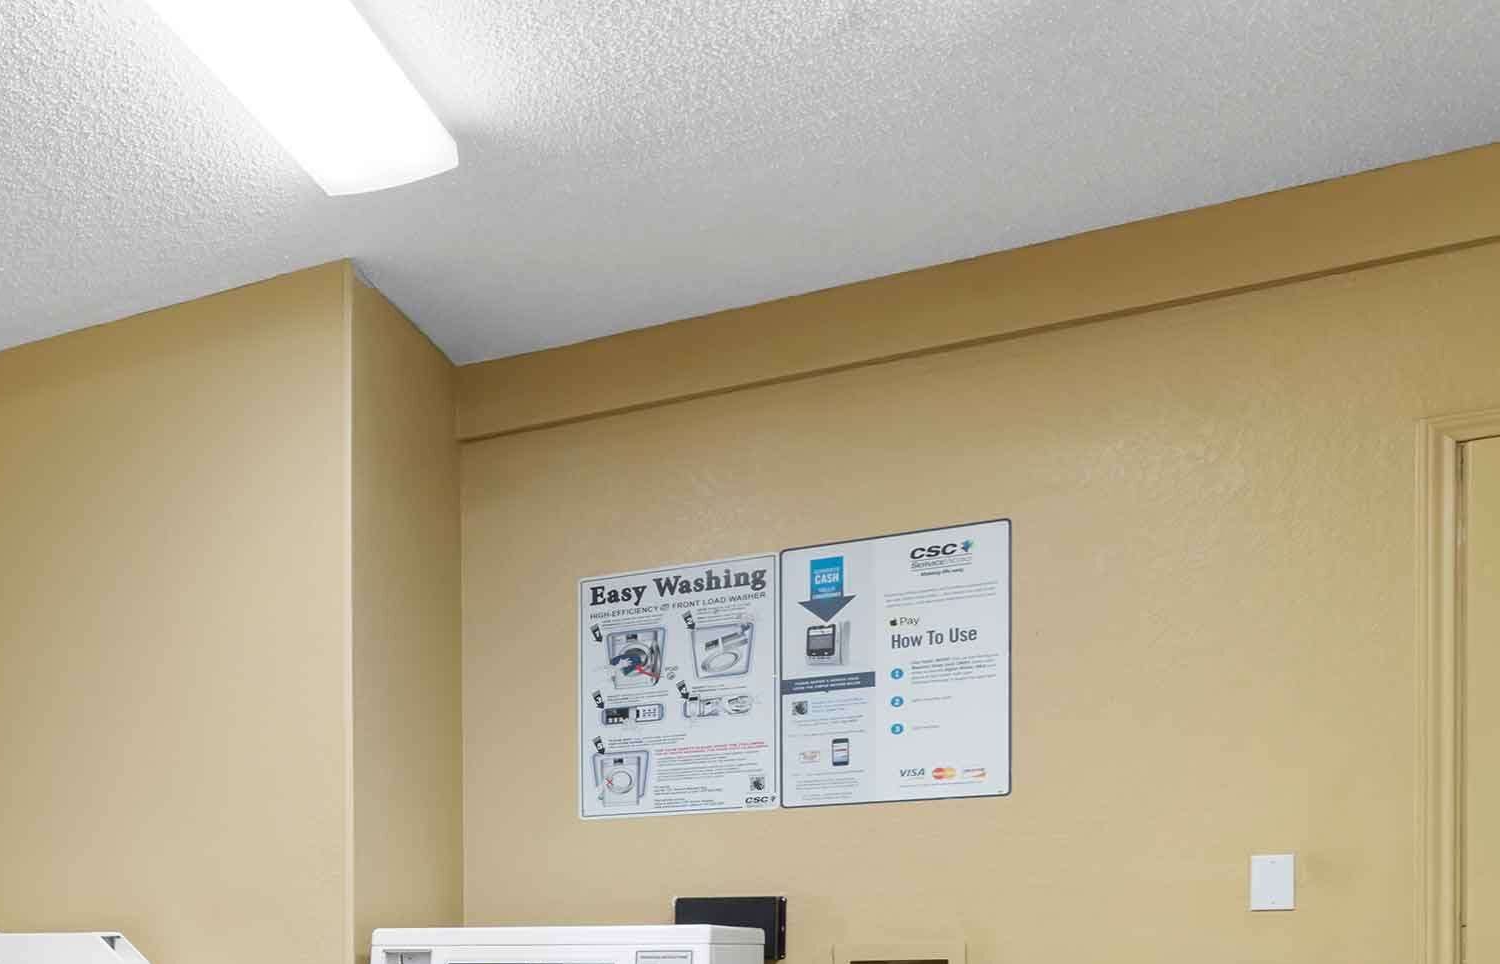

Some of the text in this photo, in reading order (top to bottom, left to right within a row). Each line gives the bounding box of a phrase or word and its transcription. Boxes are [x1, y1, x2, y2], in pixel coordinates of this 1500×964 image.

[910, 543, 958, 560] CSC
[814, 572, 840, 585] CASH
[590, 569, 767, 607] Easy Washing
[590, 606, 660, 620] HIGH-EFFICIENCY
[672, 601, 700, 609] FRONT
[702, 596, 726, 606] LOAD
[728, 591, 767, 602] WASHER
[899, 615, 920, 627] Pay
[891, 627, 977, 650] How To Use
[900, 767, 926, 777] VISA
[745, 796, 769, 804] CSC
